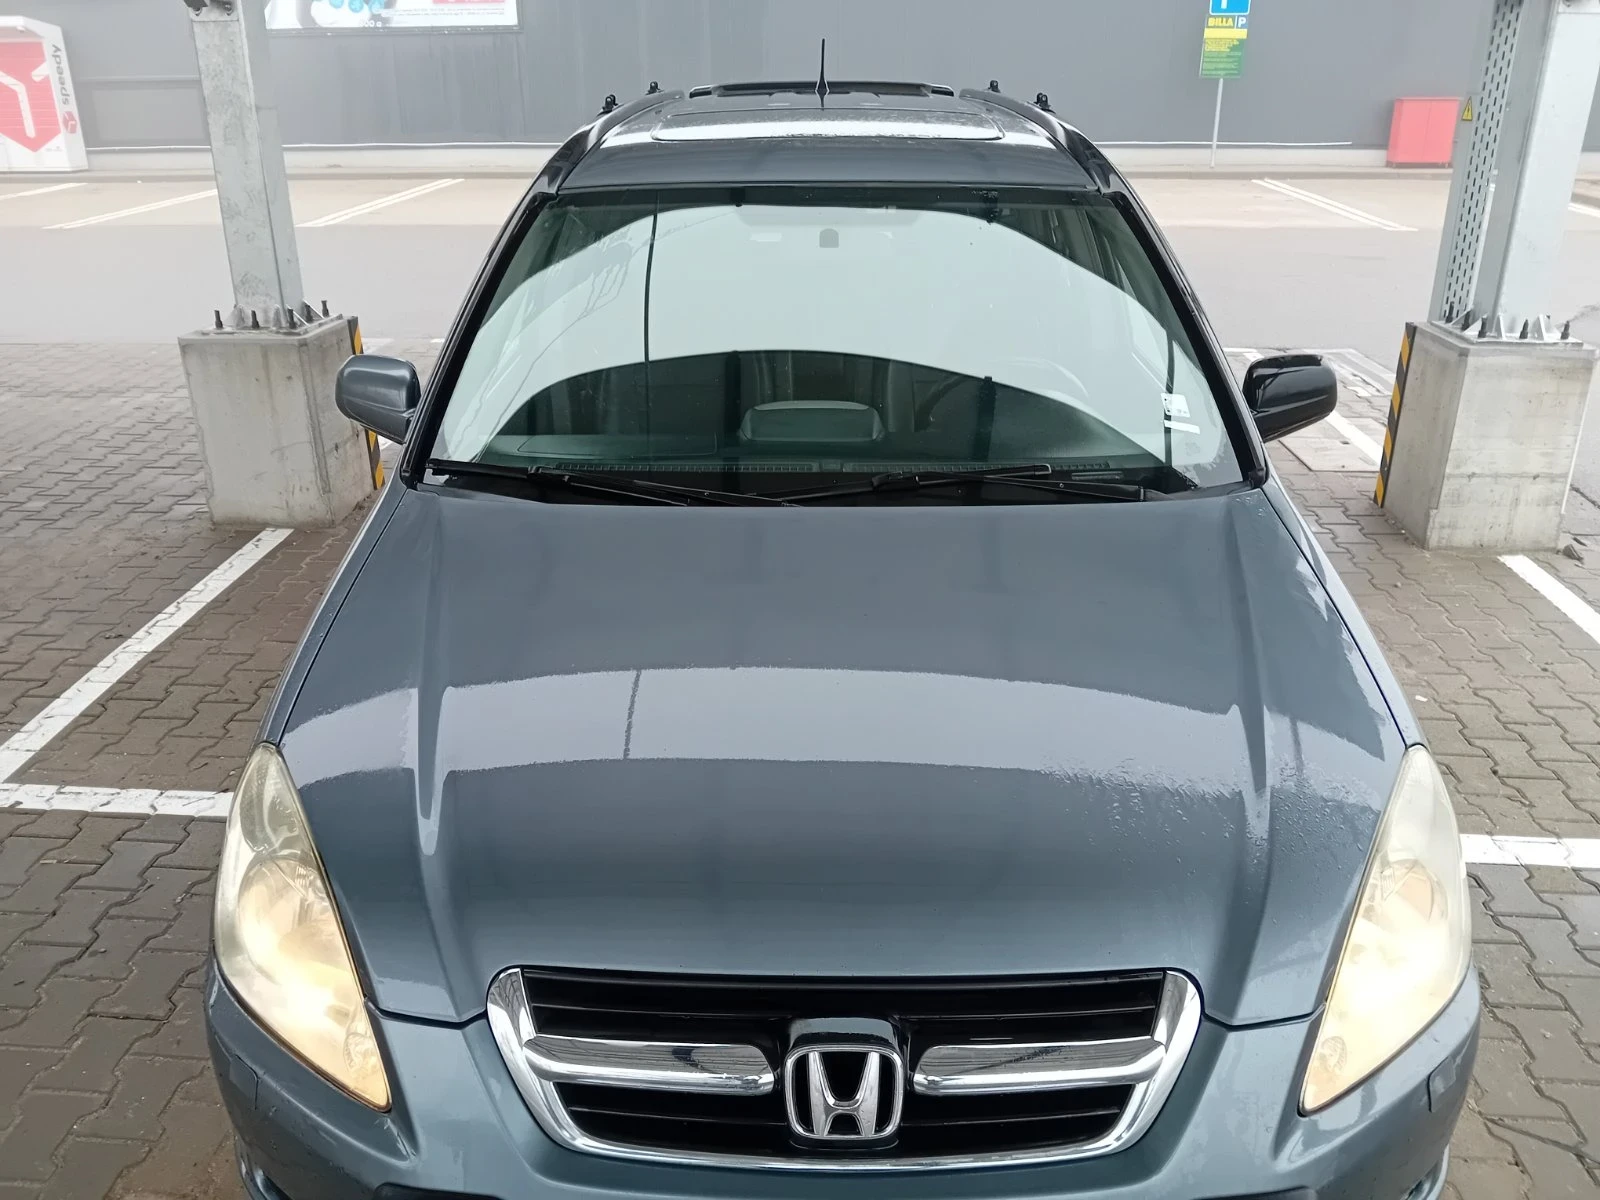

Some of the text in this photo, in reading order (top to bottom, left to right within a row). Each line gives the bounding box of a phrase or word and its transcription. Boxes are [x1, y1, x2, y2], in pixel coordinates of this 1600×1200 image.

[1208, 17, 1247, 27] BILLA P
[52, 44, 70, 105] speedy
